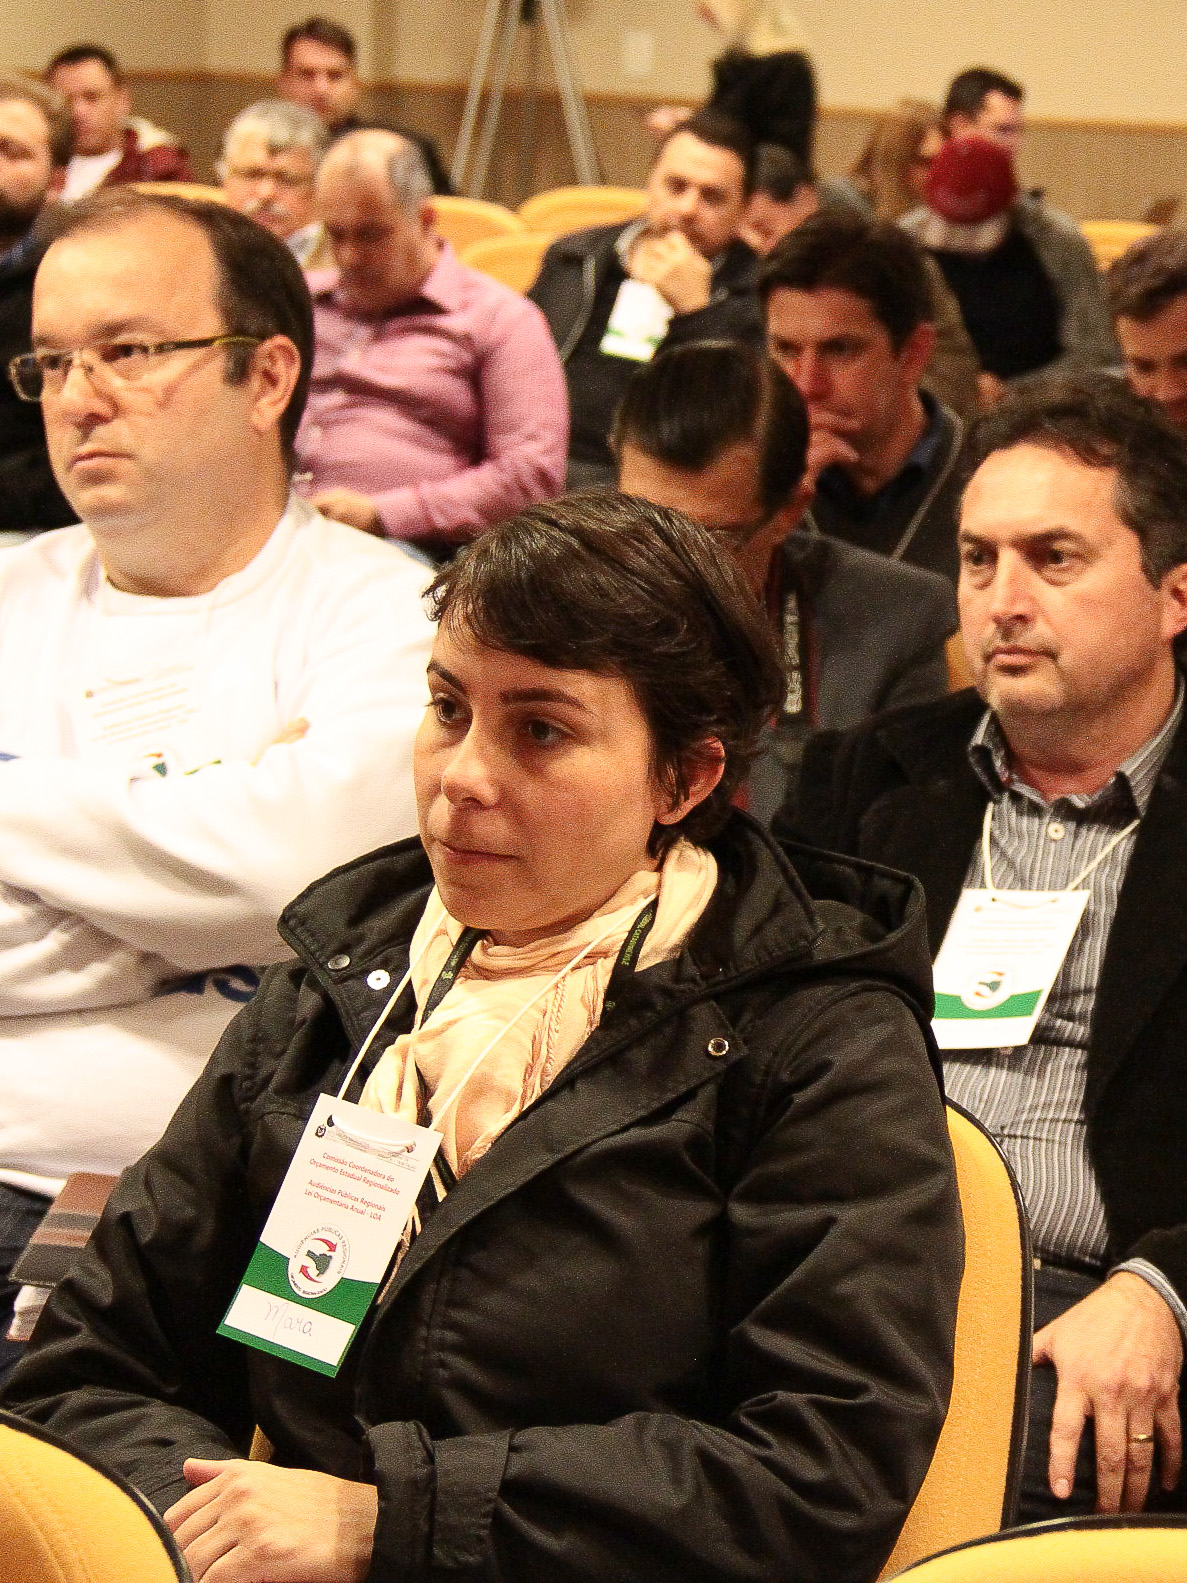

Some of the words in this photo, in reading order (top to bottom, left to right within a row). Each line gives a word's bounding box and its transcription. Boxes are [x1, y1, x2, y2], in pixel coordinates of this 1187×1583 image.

[309, 1158, 339, 1174] Orçamento
[339, 1168, 362, 1181] Estadual
[362, 1176, 401, 1195] Regionalizado
[348, 1161, 386, 1180] Coordenadora
[304, 1189, 312, 1197] Lei
[349, 1204, 366, 1216] Anual
[369, 1211, 382, 1221] LOA
[308, 1179, 337, 1194] Audiências
[337, 1188, 359, 1202] Públicas
[359, 1197, 386, 1212] Regionais
